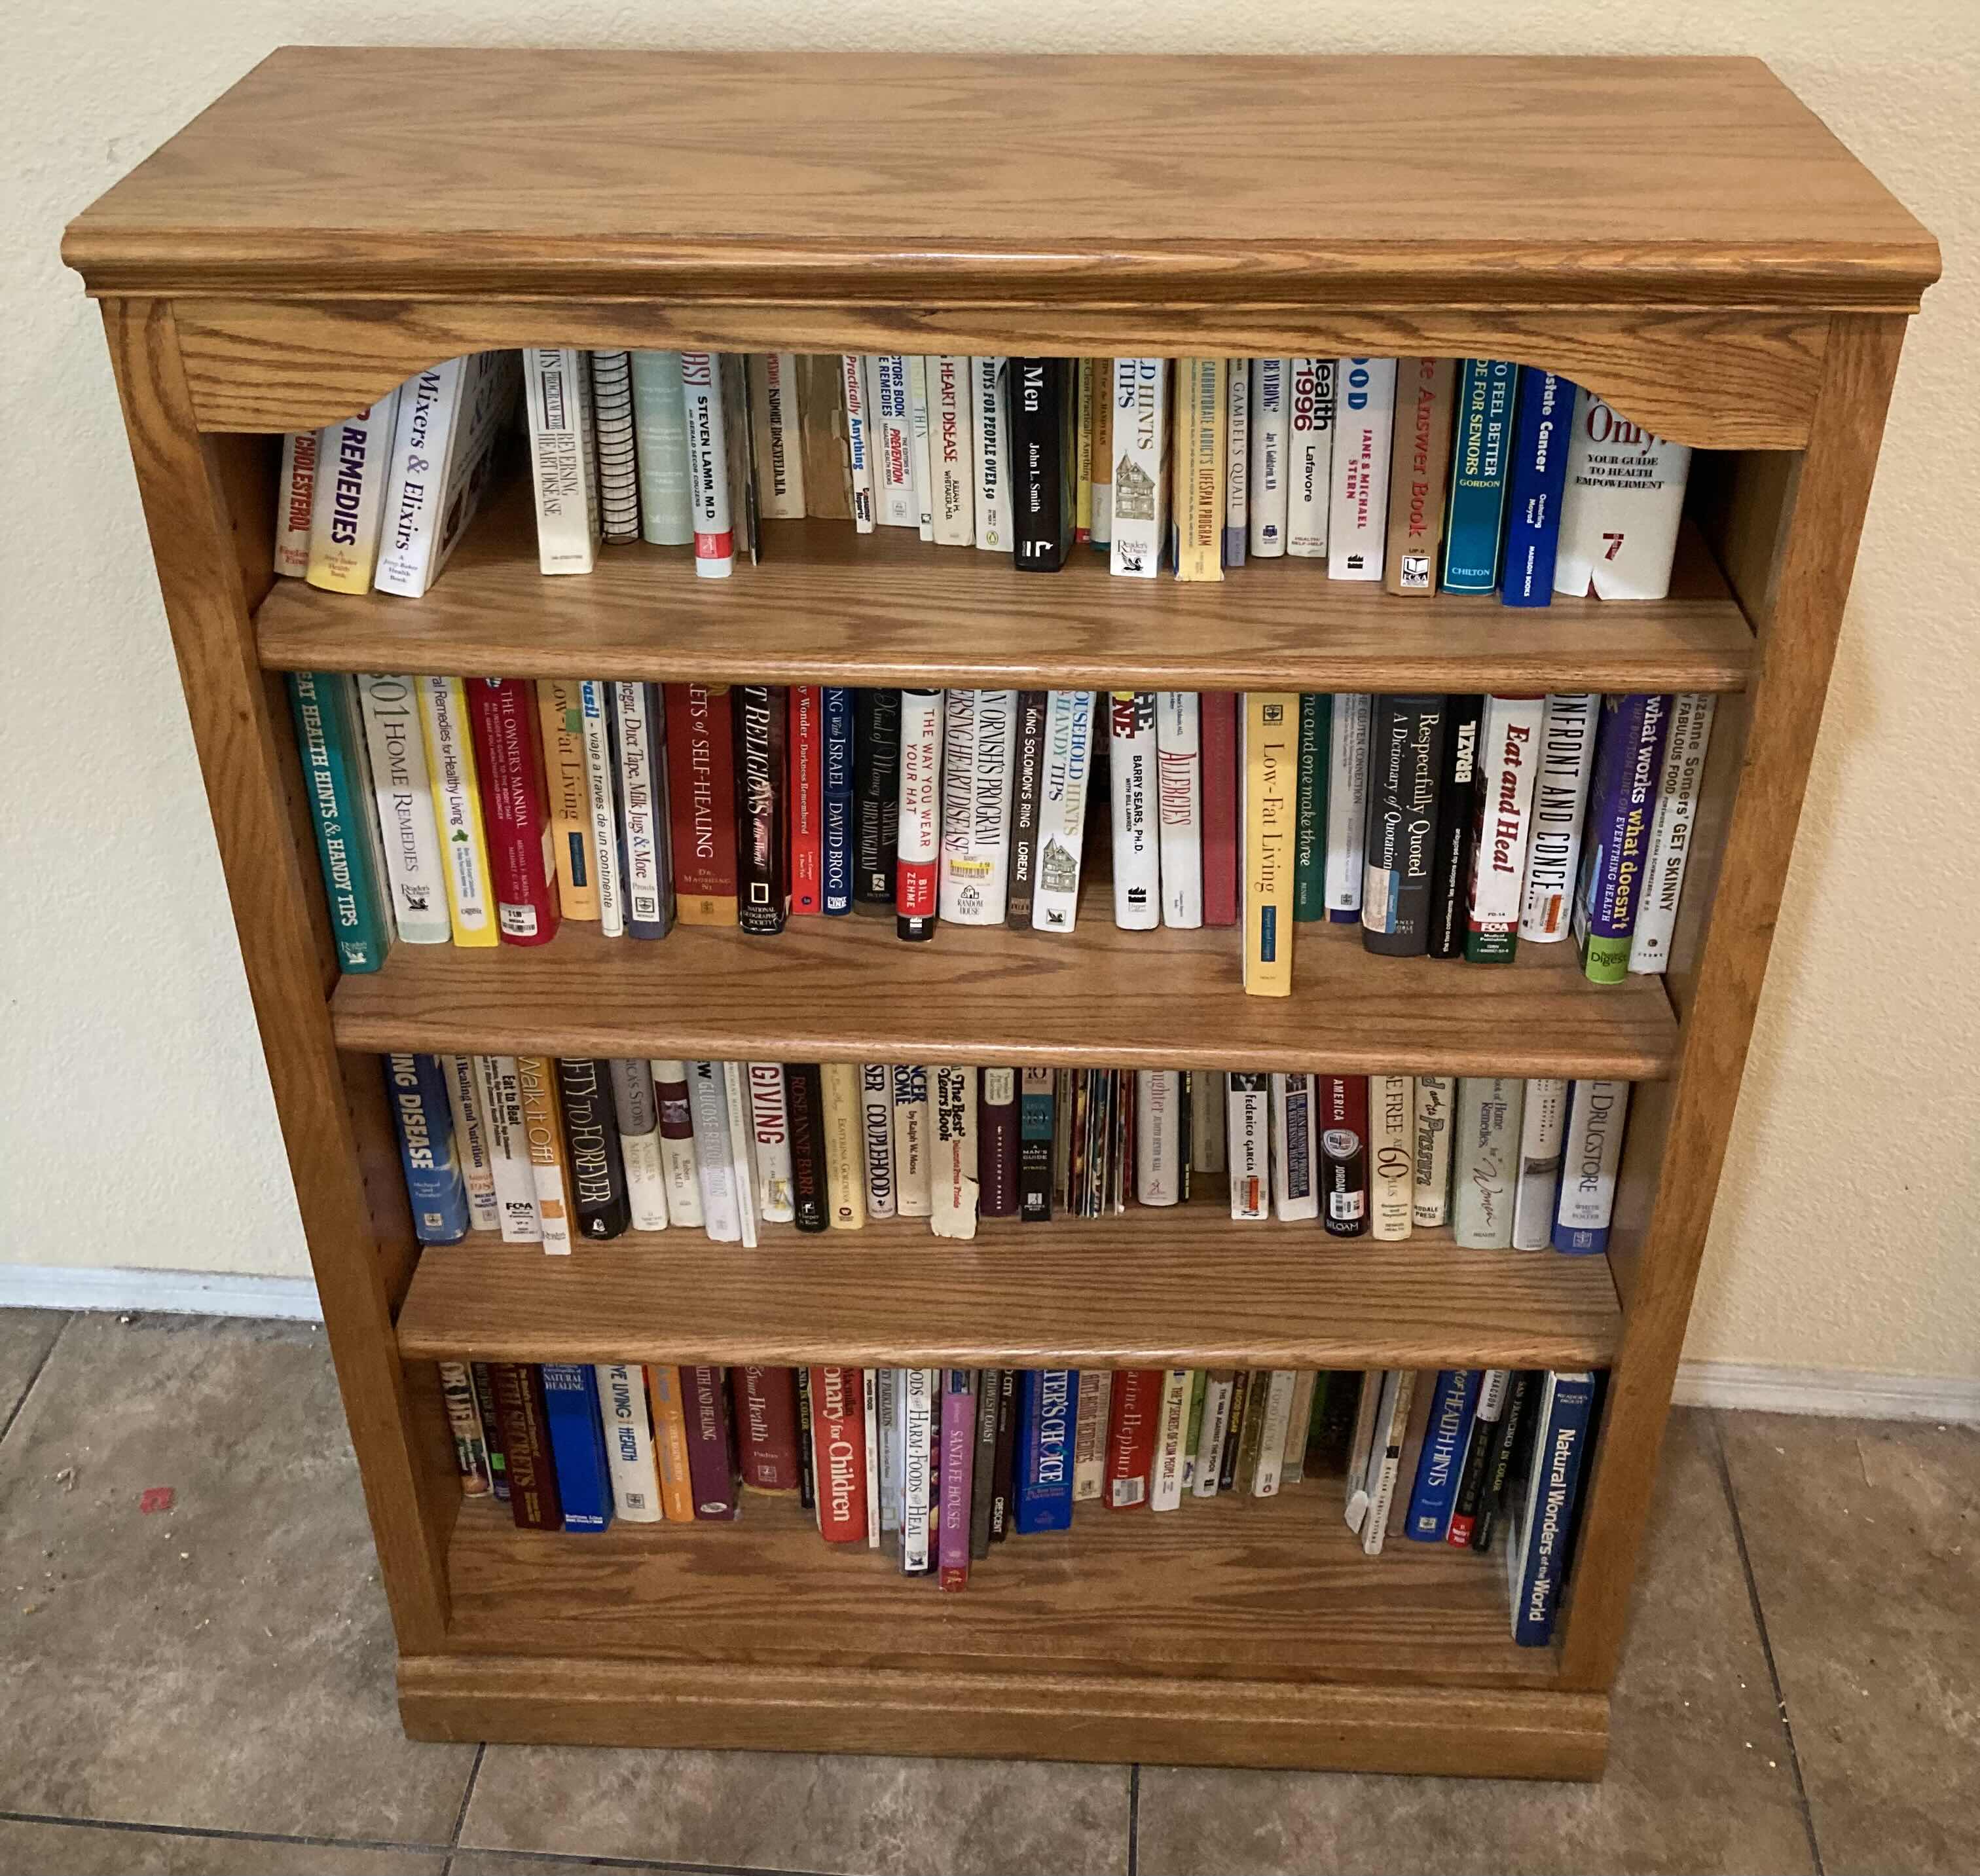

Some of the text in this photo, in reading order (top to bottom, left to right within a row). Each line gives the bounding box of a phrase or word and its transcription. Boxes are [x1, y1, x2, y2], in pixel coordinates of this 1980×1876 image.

[880, 366, 892, 416] REMEDIES
[894, 388, 905, 417] BOOK
[1024, 365, 1042, 411] Men
[1119, 363, 1135, 407] TIPS
[1294, 370, 1315, 431] 1996
[846, 356, 864, 470] Practically Anything
[941, 362, 958, 463] HEART DISEASE
[1138, 384, 1154, 450] HINTS
[1465, 381, 1487, 475] FOR SENIORS
[1484, 382, 1503, 477] FEEL BETTER
[395, 371, 440, 551] Mixers & Elixirs
[557, 433, 578, 496] REVERSING
[698, 395, 715, 522] STEVEN LAMM, M.D.
[889, 428, 904, 484] PREVENTION
[1363, 429, 1373, 459] JANE
[1409, 386, 1436, 538] Answer Book
[1535, 421, 1553, 472] Cancer
[1588, 454, 1659, 466] YOUR GUIDE
[288, 436, 315, 532] CHOLESTEROL
[332, 427, 367, 545] REMEDIES
[1029, 443, 1040, 512] John L. Smith
[1304, 445, 1315, 502] Lafavore
[1346, 460, 1358, 499] STERN
[1459, 479, 1500, 488] GORDON
[1576, 475, 1665, 489] EMPOWERMENT
[1590, 466, 1653, 477] TO HEALTH
[1357, 473, 1370, 529] MICHAEL
[1527, 498, 1536, 524] Moyad
[1452, 567, 1490, 576] CHILTON
[1524, 545, 1535, 597] MADISON BOOKS
[799, 697, 810, 738] Wonder
[430, 690, 464, 826] Remedies for Healthy Living
[587, 731, 600, 760] viaje
[829, 737, 847, 792] ISRAEL
[1020, 708, 1037, 828] KING SOLOMON'S RING
[1133, 754, 1143, 784] BARRY
[383, 722, 418, 872] HOME REMEDIES
[593, 776, 604, 810] traves
[623, 718, 648, 879] Duct Tape, Milk Jugs & More
[906, 744, 917, 815] YOUR HAT
[920, 708, 935, 847] THE WAY YOU WEAR
[1493, 723, 1530, 874] Eat and Heal
[1539, 785, 1577, 822] AND
[596, 813, 606, 827] de
[1133, 787, 1143, 826] SEARS,
[598, 832, 606, 845] un
[829, 803, 844, 890] DAVID BROG
[1016, 841, 1029, 881] LORENZ
[599, 849, 612, 908] continente
[906, 872, 916, 908] ZEHME
[918, 878, 928, 902] BILL
[959, 907, 980, 915] HOUSE
[503, 1075, 521, 1126] Eat to Beat
[519, 1057, 554, 1164] Walk It Off!
[751, 1066, 784, 1145] GIVING
[938, 1068, 952, 1141] Years Book
[951, 1075, 966, 1137] The Best
[1333, 1079, 1344, 1121] AMERICA
[1386, 1093, 1403, 1135] FREE
[398, 1094, 435, 1169] DISEASE
[791, 1075, 815, 1196] ROSEANNE BARR
[866, 1104, 890, 1198] COUPLEHOOD
[907, 1111, 919, 1175] by Ralph W. Moss
[1579, 1095, 1614, 1193] DRUGSTORE
[1336, 1166, 1346, 1192] JORDAN
[1377, 1147, 1410, 1178] 60
[613, 1383, 632, 1418] LIVING
[698, 1388, 716, 1441] AND HEALING
[618, 1427, 638, 1462] HEALTH
[983, 1414, 993, 1444] COAST
[1211, 1444, 1219, 1455] THE
[1213, 1416, 1222, 1443] AGAINST
[829, 1425, 856, 1523] for Children
[908, 1410, 929, 1539] HARM FOODS HEAL
[947, 1429, 964, 1530] SANTA FE HOUSES
[1208, 1455, 1217, 1473] POOR
[1550, 1428, 1576, 1488] Natural
[993, 1496, 1004, 1534] CRESCENT
[1539, 1487, 1566, 1556] Wonders
[1530, 1579, 1552, 1623] World
